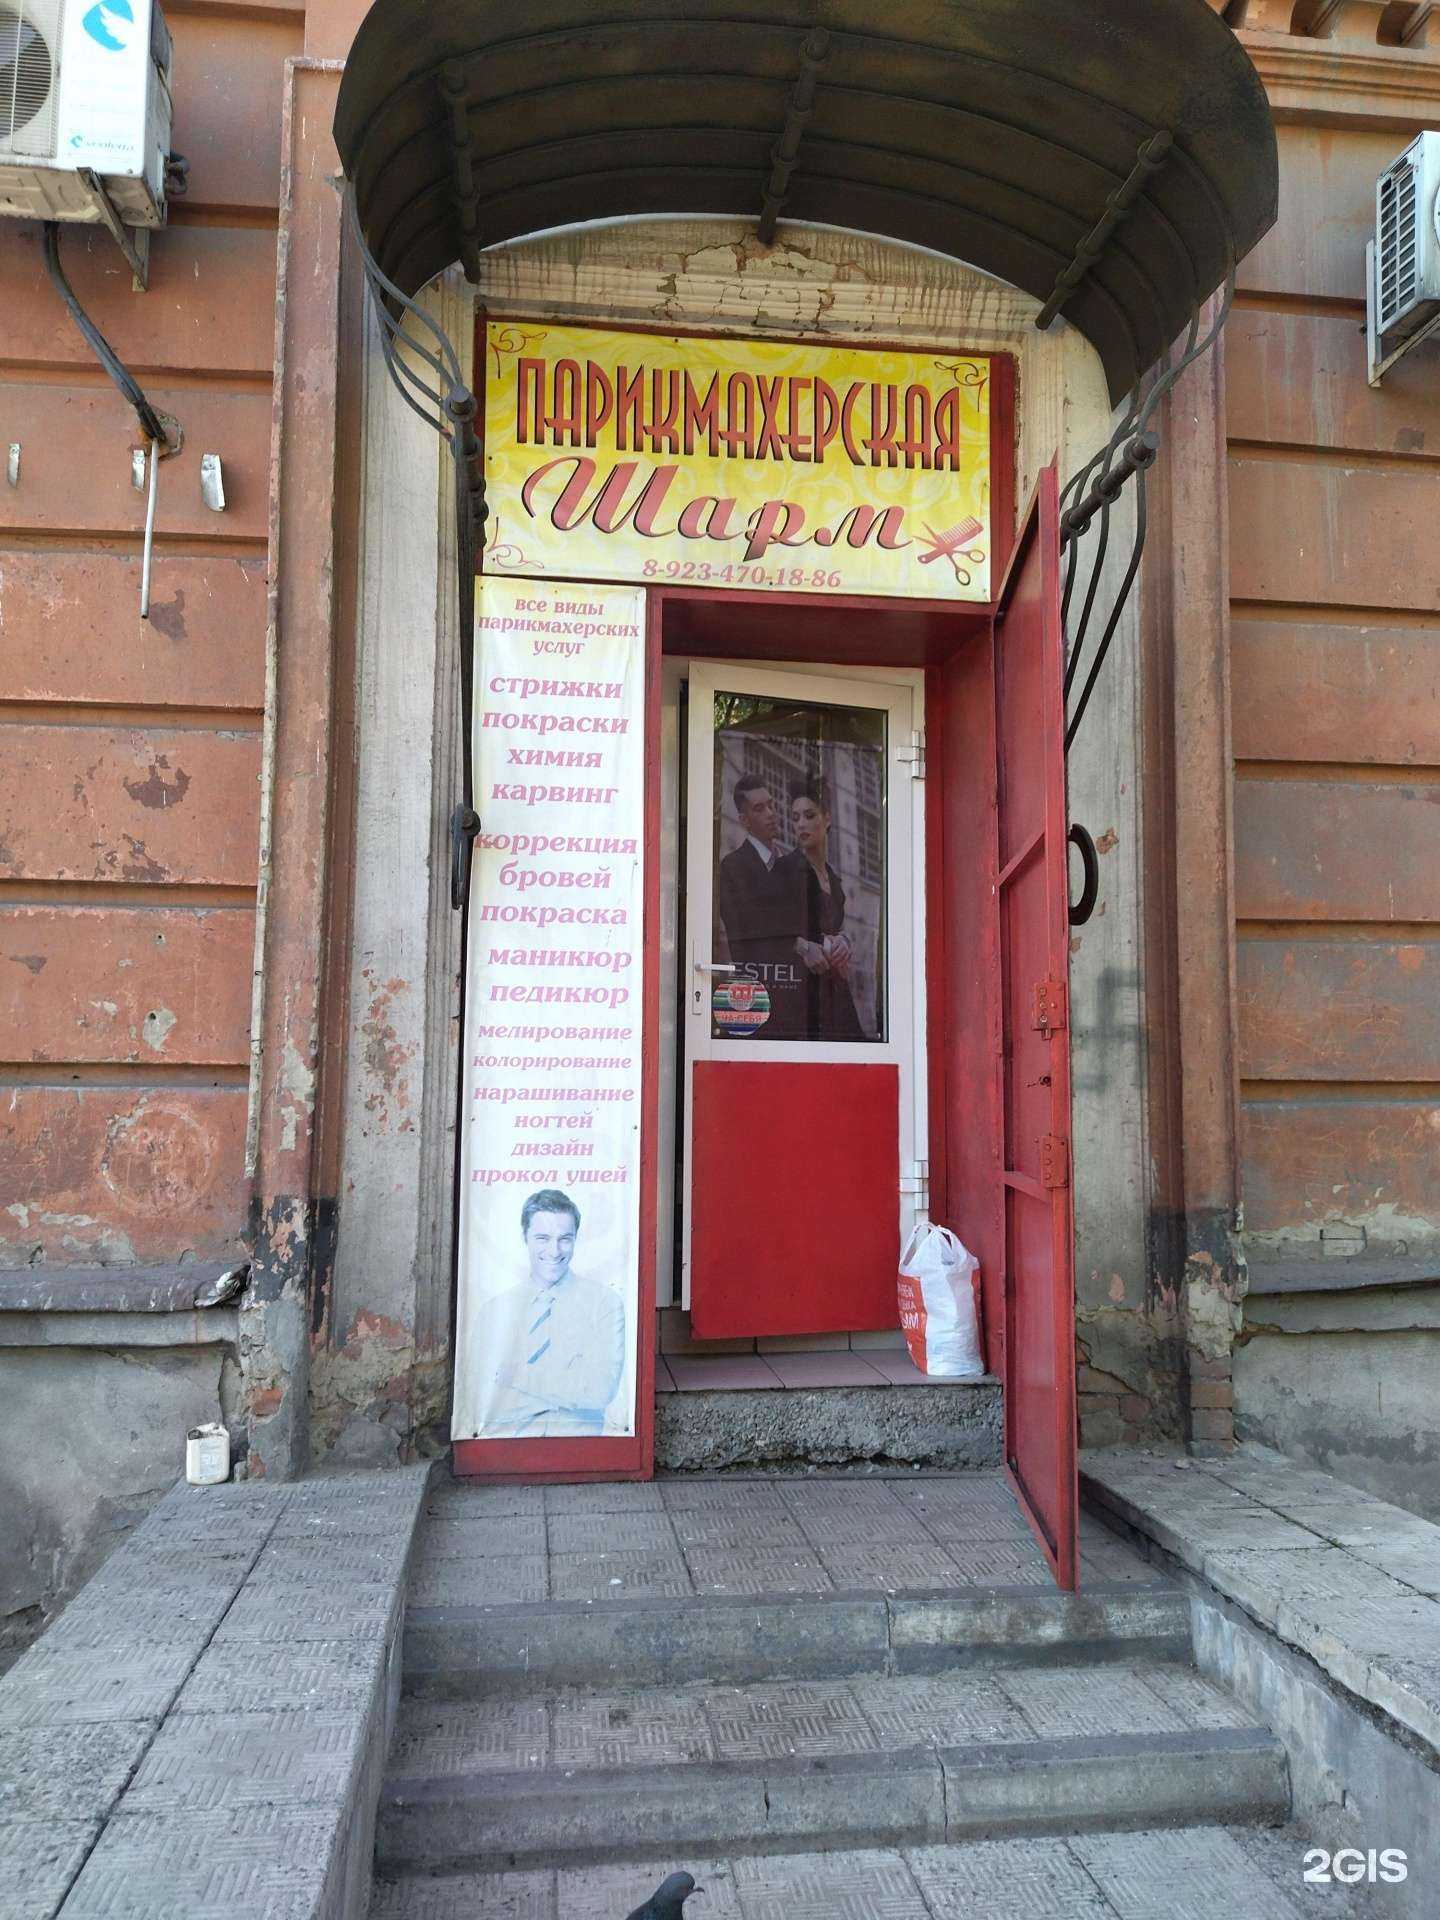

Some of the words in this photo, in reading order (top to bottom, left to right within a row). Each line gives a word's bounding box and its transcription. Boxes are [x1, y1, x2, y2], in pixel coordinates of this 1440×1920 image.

[516, 357, 960, 472] ПАРИКМАХЕРСКАЯ
[521, 455, 914, 562] Шарм
[642, 559, 841, 588] 8-923-470-18-86
[515, 598, 548, 613] все
[554, 601, 604, 616] виды
[478, 616, 640, 638] парикмахерских
[533, 639, 585, 658] услуг
[489, 676, 624, 699] стрижки
[482, 711, 629, 735] покраски
[507, 748, 603, 768] химия
[491, 783, 619, 806] карвинг
[474, 832, 638, 856] коррекция
[499, 860, 612, 892] бровей
[480, 904, 628, 928] покраска
[488, 948, 633, 973] маникюр
[728, 962, 803, 983] ESTEL
[489, 984, 630, 1009] педикюр
[478, 1025, 633, 1043] мелирование
[472, 1055, 633, 1071] колорирование
[513, 1111, 594, 1129] ногтей
[511, 1138, 594, 1157] дизайн
[471, 1169, 559, 1187] прокол
[565, 1165, 627, 1187] ушей
